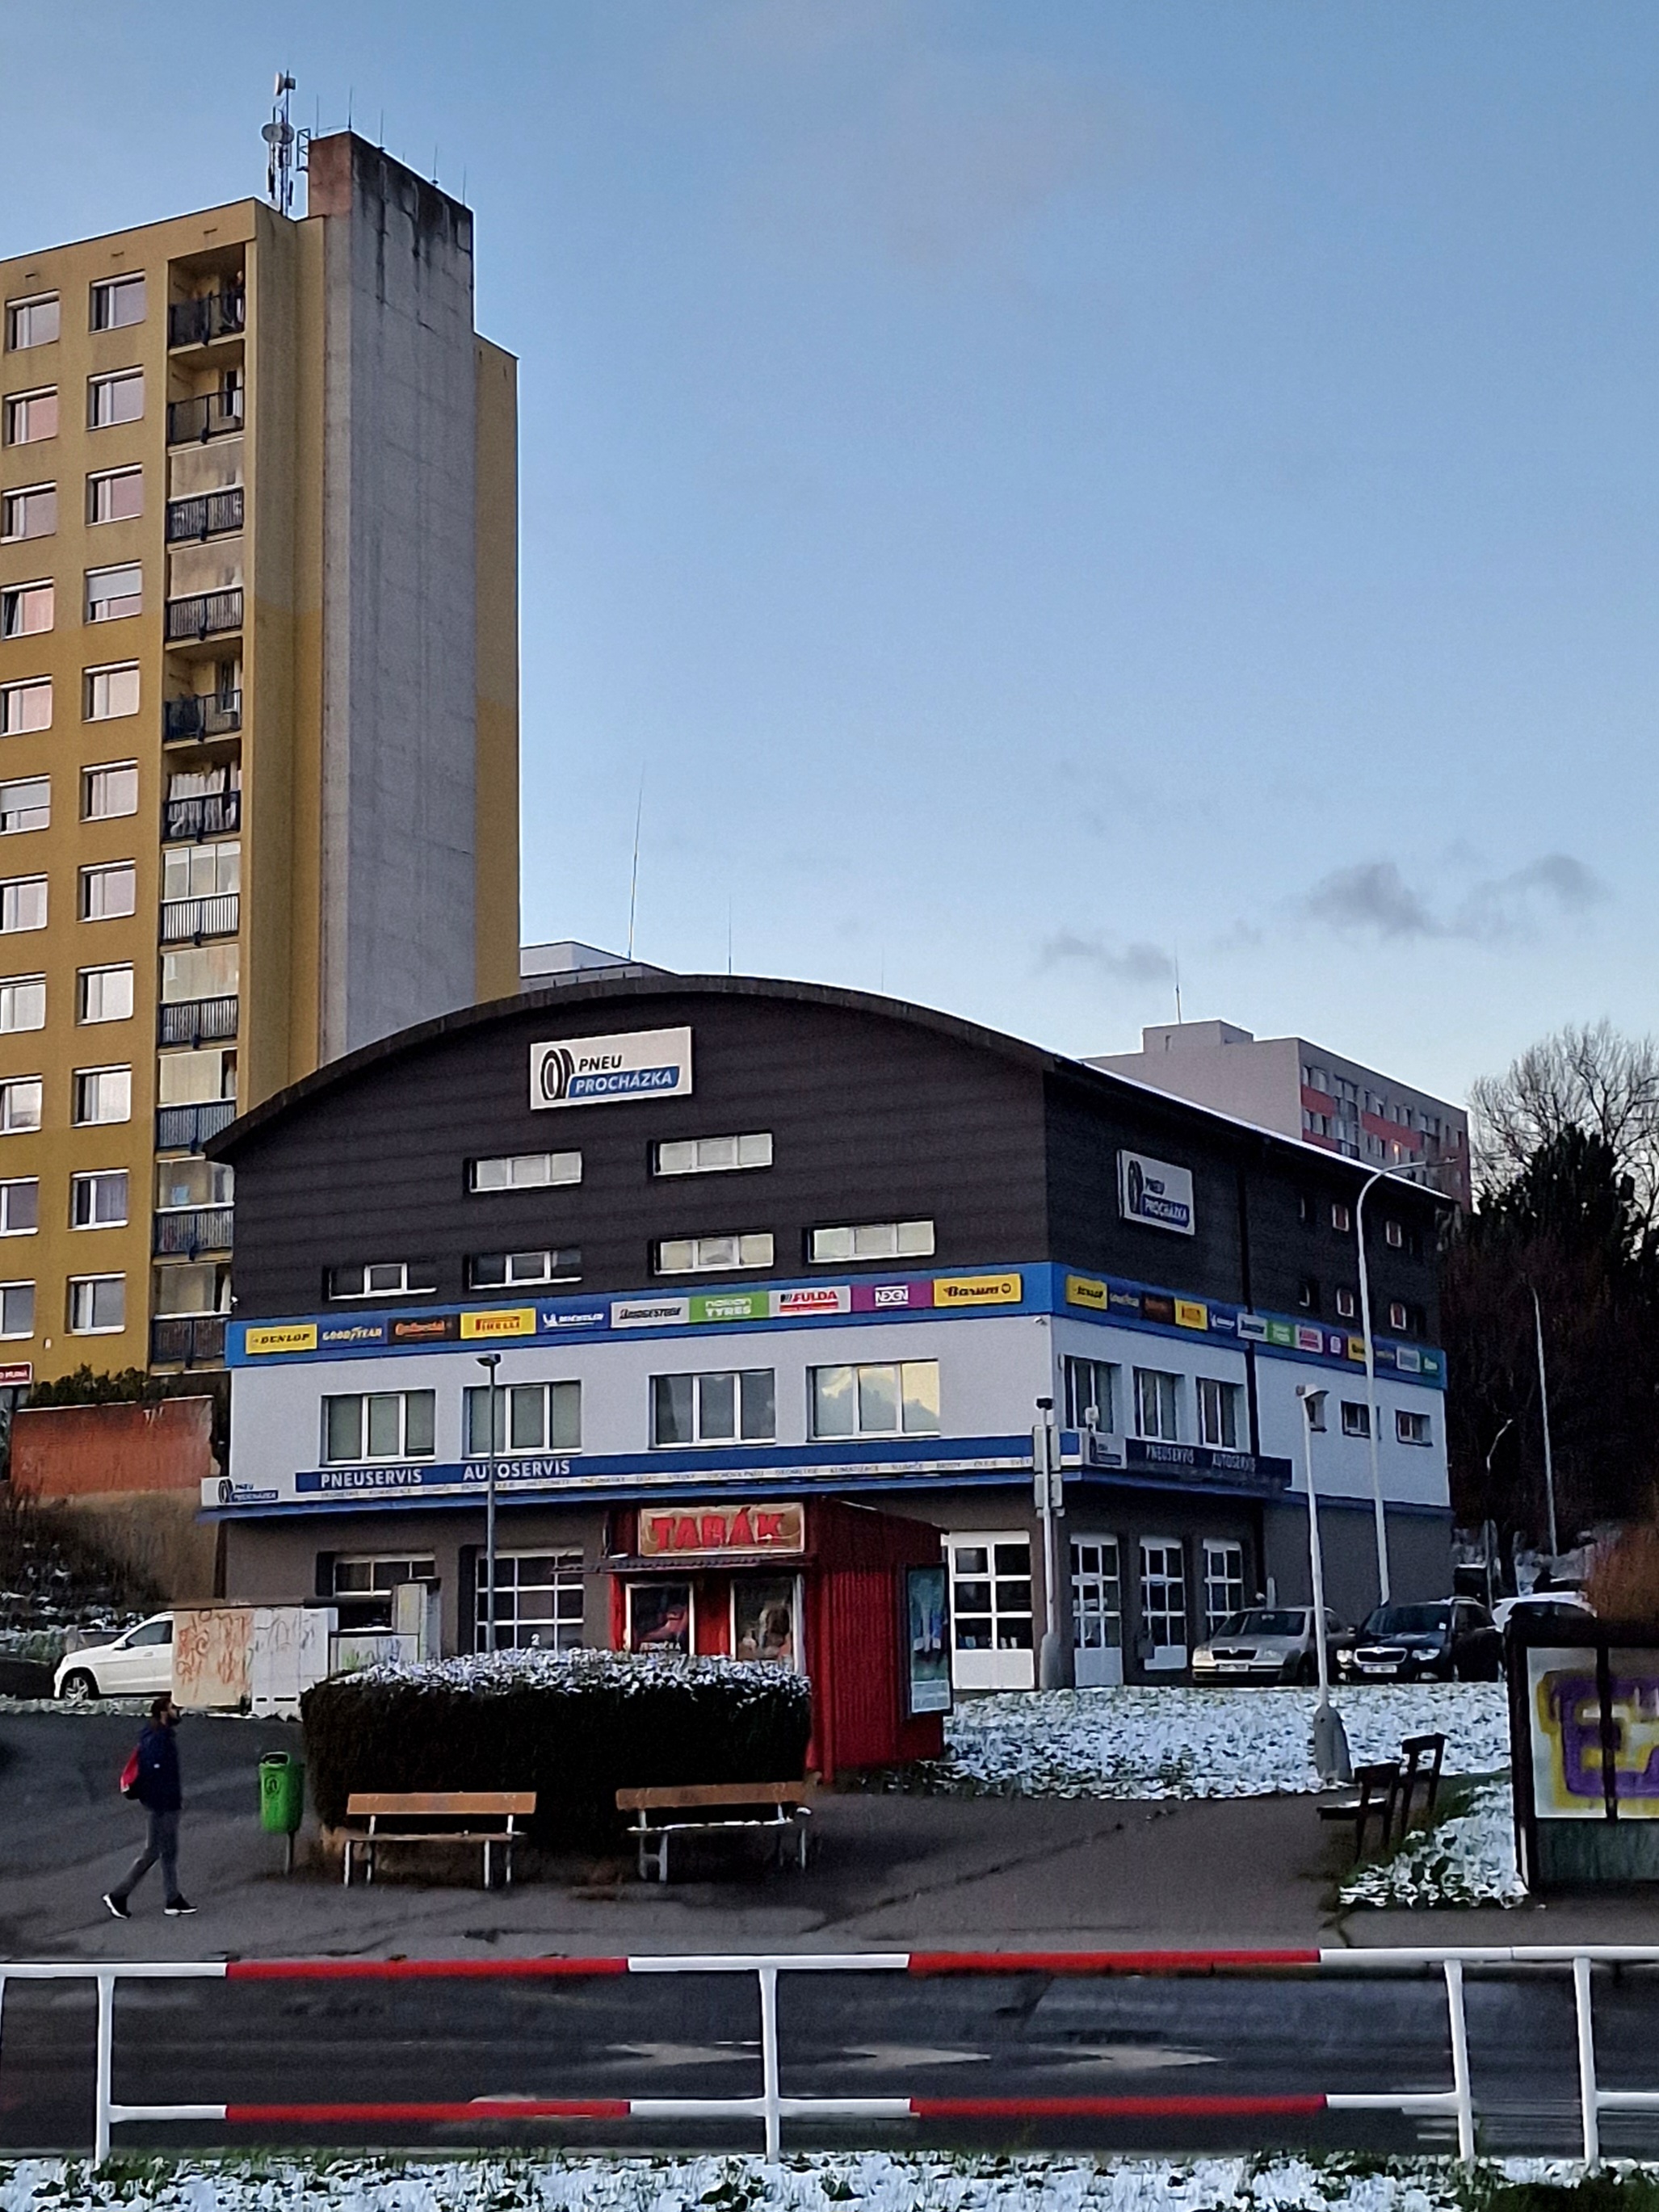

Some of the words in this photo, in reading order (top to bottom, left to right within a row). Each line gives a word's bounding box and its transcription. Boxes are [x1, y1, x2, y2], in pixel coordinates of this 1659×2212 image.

[578, 1055, 622, 1072] PNEU
[575, 1070, 673, 1093] PROCHÁZKA
[792, 1291, 838, 1303] FULDA
[943, 1285, 999, 1297] Barum
[475, 1316, 520, 1332] PIRELLI
[260, 1333, 310, 1345] DUNLOP
[322, 1326, 383, 1341] GOODYEAR
[321, 1468, 422, 1488] PNEUSERVIS
[651, 1506, 785, 1551] TABÁK
[531, 1633, 540, 1646] 2
